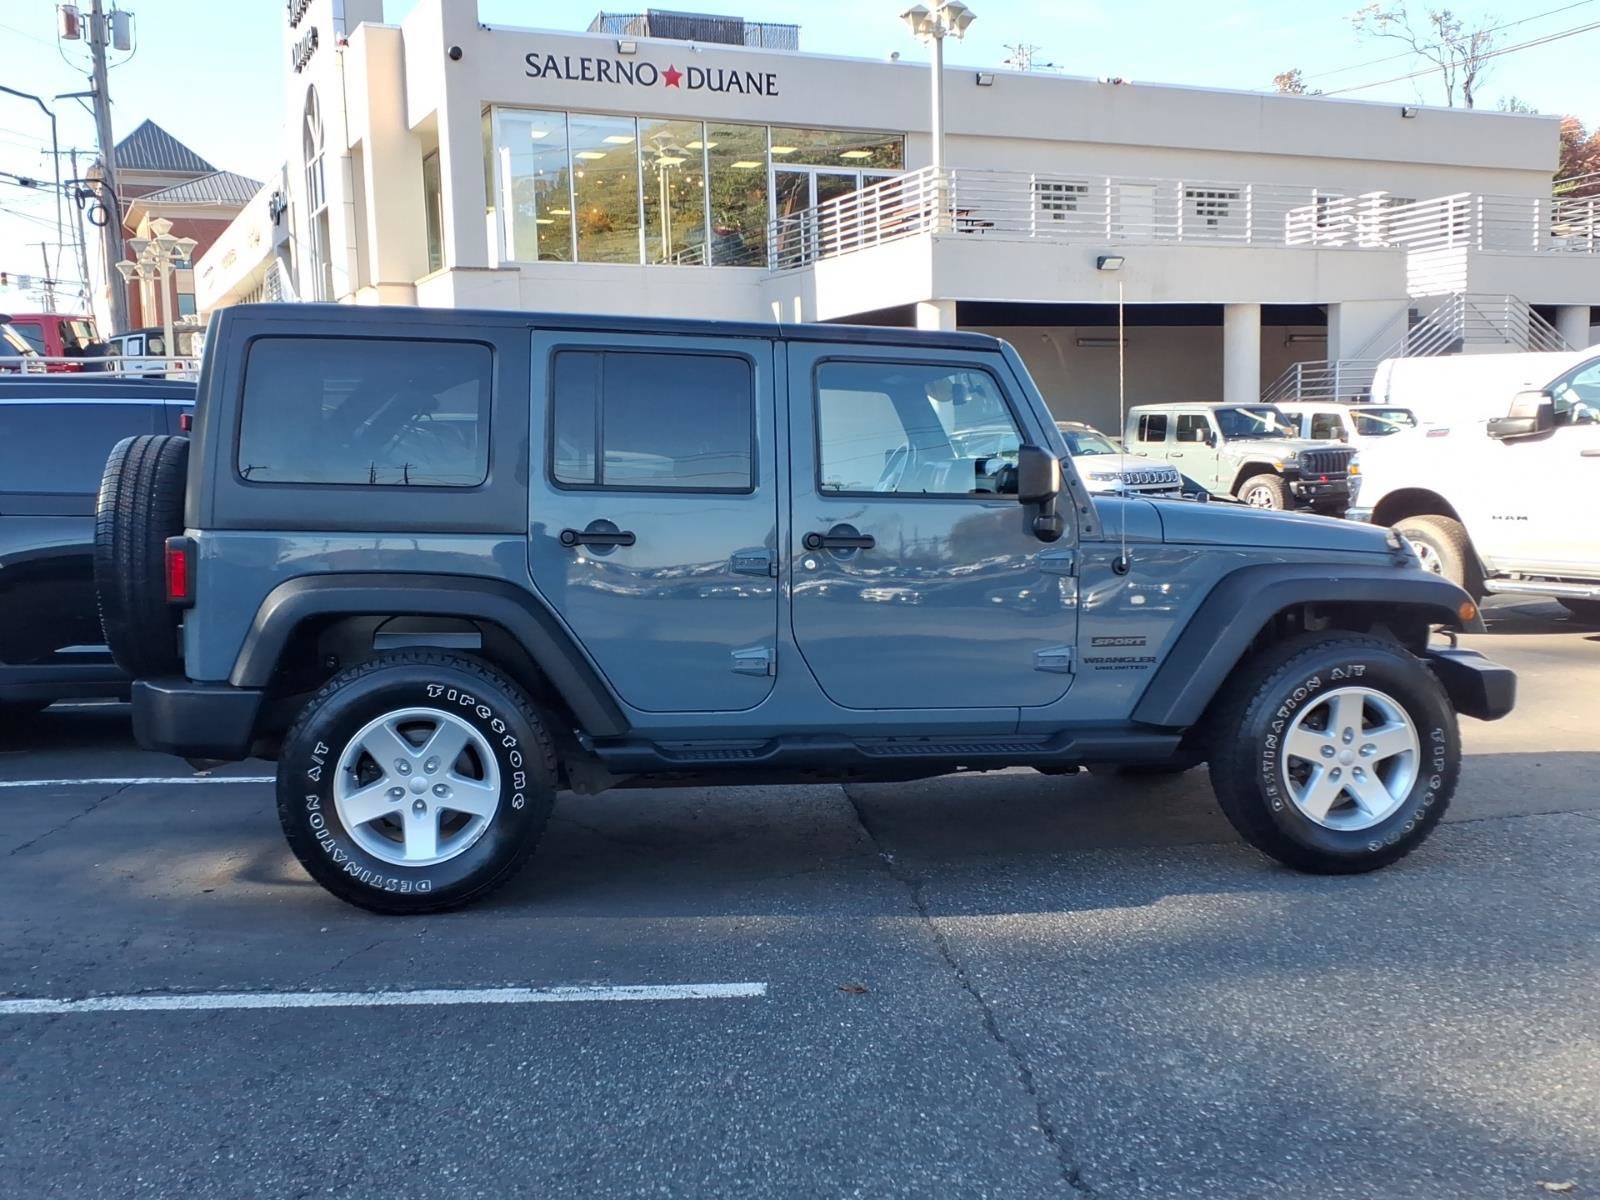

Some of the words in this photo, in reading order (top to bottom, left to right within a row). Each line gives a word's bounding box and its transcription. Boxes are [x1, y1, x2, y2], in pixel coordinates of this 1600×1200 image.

[525, 52, 658, 87] SALERNO
[686, 66, 780, 96] DUANE
[1083, 656, 1157, 664] WRANGLER
[1091, 636, 1146, 648] SPORT
[426, 684, 526, 810] Firestone
[1262, 676, 1321, 812] DESTINATION
[1330, 664, 1366, 681] A/T
[307, 741, 329, 782] A/T
[305, 794, 432, 893] DESTINATION
